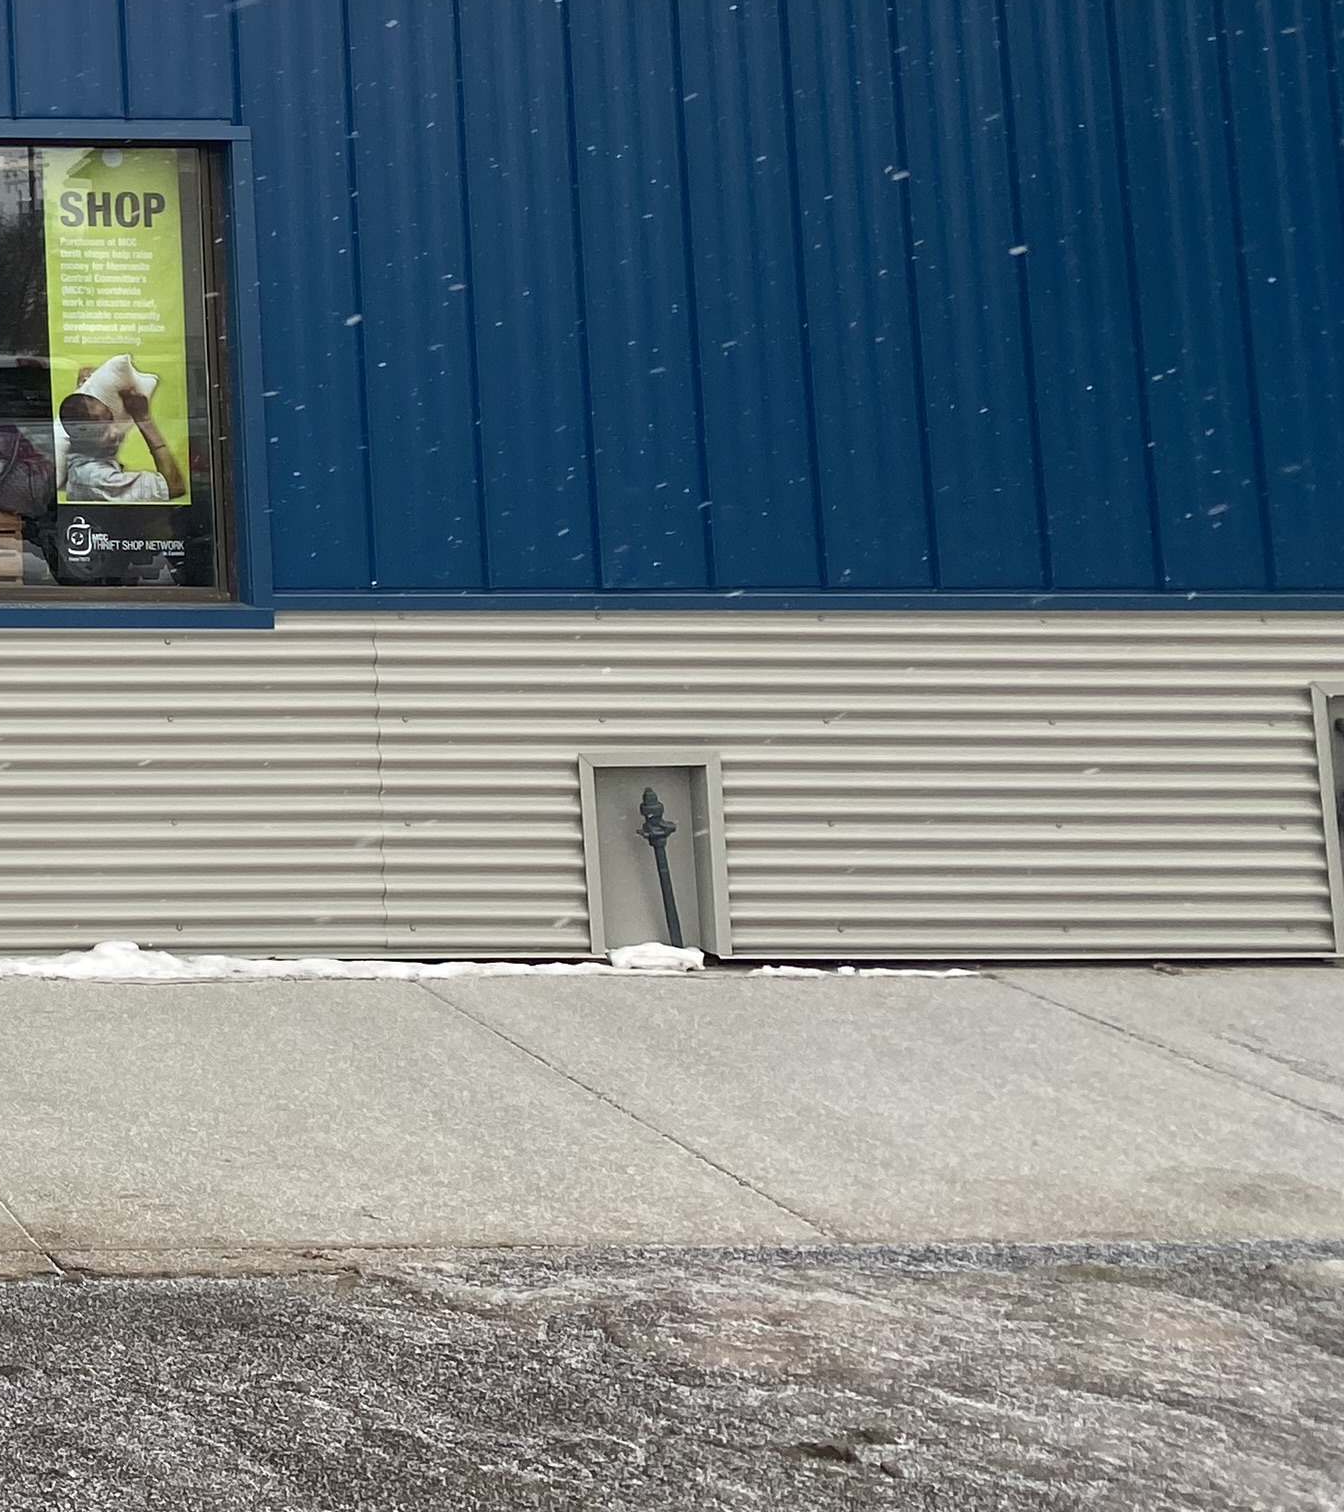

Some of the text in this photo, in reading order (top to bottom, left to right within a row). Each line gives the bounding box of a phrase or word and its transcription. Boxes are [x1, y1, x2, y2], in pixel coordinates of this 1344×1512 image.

[60, 191, 166, 228] SHOP
[93, 541, 185, 550] THRIFT SHOP NETWORK
